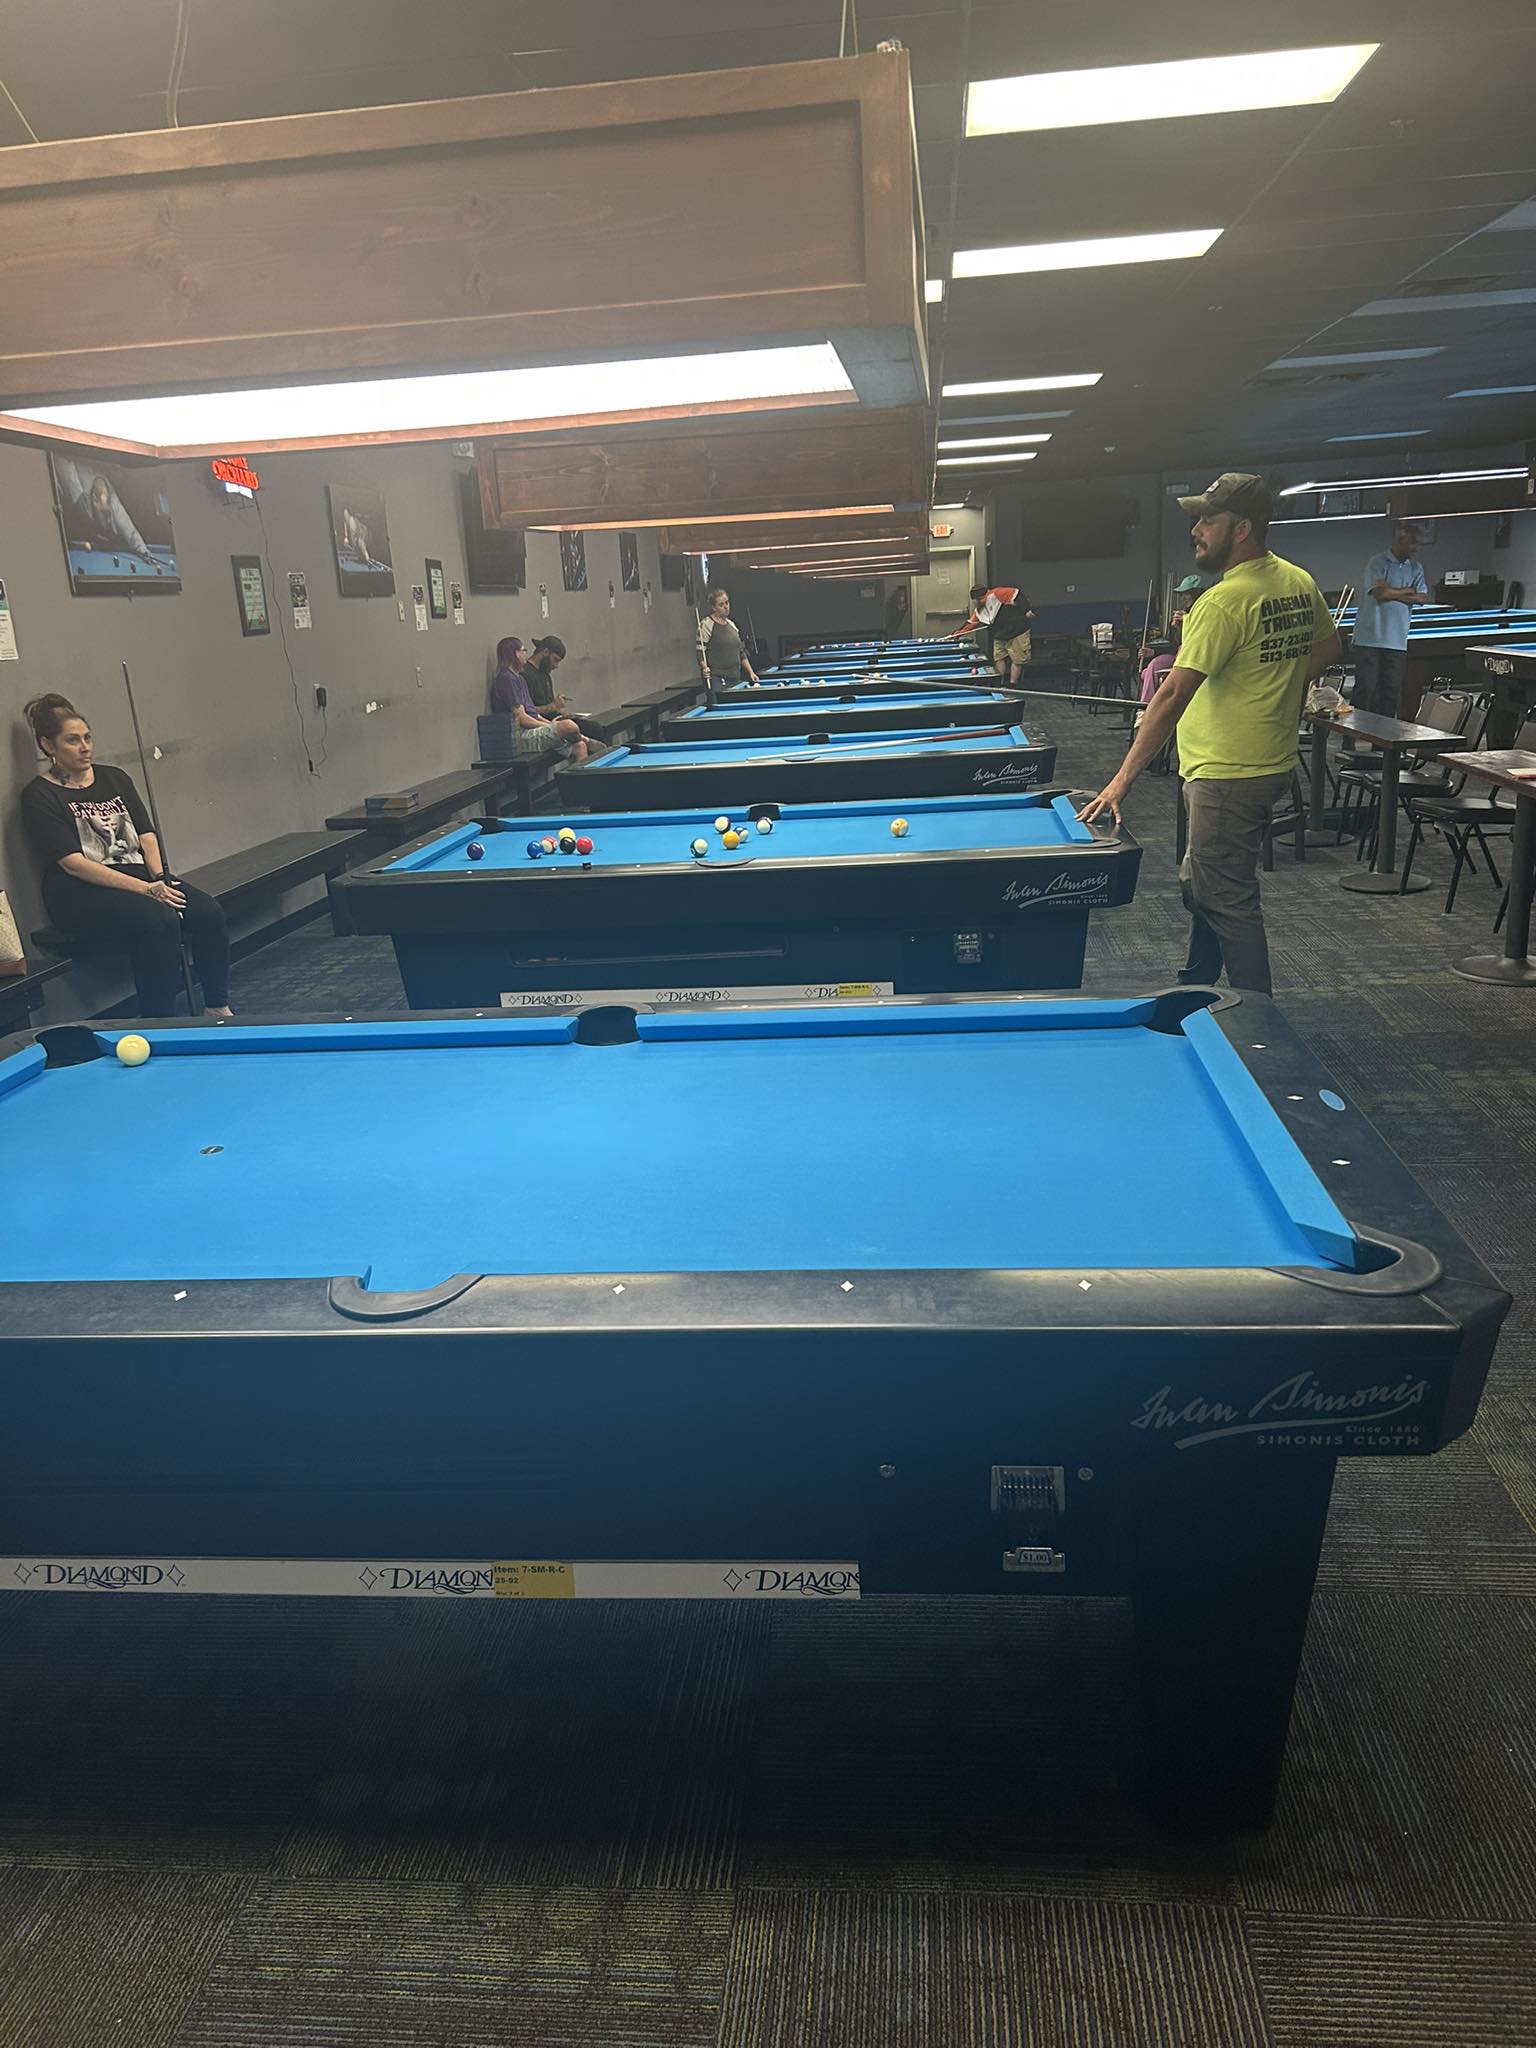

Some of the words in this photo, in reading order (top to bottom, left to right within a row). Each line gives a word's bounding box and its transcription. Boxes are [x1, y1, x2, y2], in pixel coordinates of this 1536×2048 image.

[68, 802, 79, 812] IF
[95, 796, 124, 811] DON'T
[517, 993, 574, 1006] DIAMOND
[664, 989, 722, 1001] DIAMOND
[1248, 1370, 1431, 1418] Simonis
[1256, 1435, 1344, 1446] SIMONIS
[1353, 1434, 1420, 1446] CLOTH
[33, 1564, 164, 1590] DIAMOND
[521, 1566, 566, 1574] 7-SM-R-C
[379, 1568, 494, 1595] DIAMON
[745, 1569, 860, 1596] DIAMON
